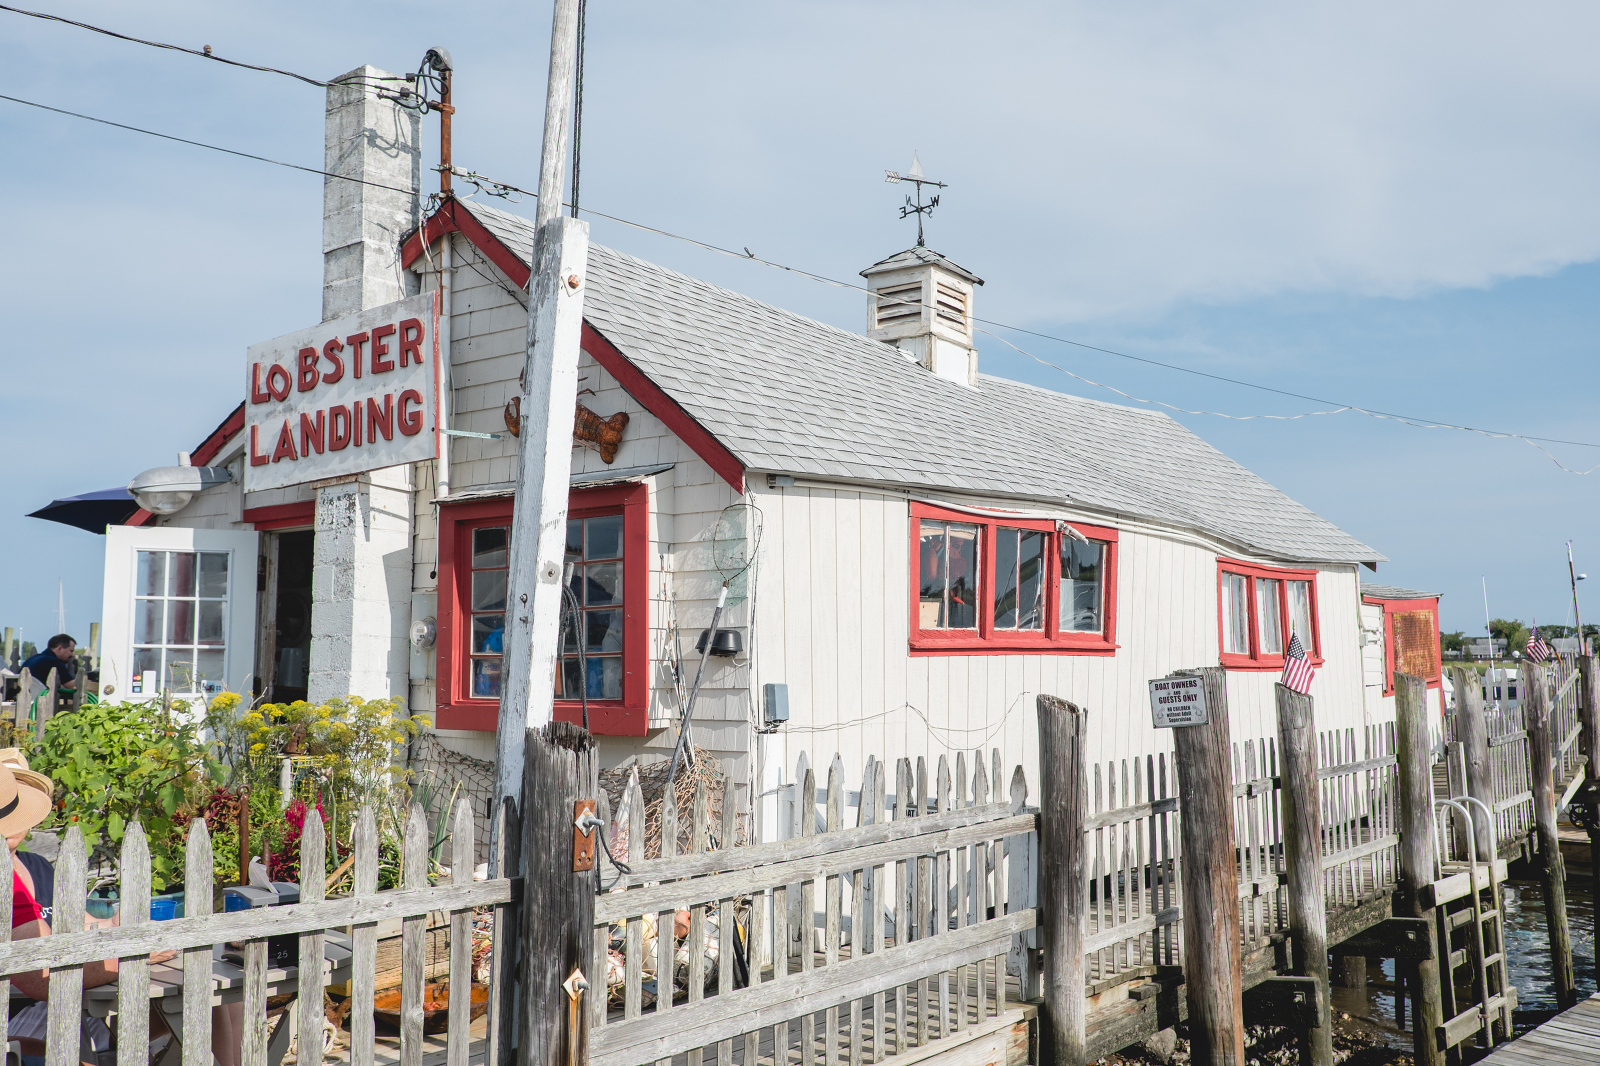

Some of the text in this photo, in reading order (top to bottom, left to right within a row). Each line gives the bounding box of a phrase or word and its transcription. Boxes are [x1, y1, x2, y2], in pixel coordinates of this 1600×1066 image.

[930, 194, 940, 207] W
[251, 318, 425, 404] LOBSTER
[250, 388, 424, 466] LANDING
[1154, 680, 1198, 690] BOAT OWNERS
[1158, 694, 1198, 704] GUESTS ONLY
